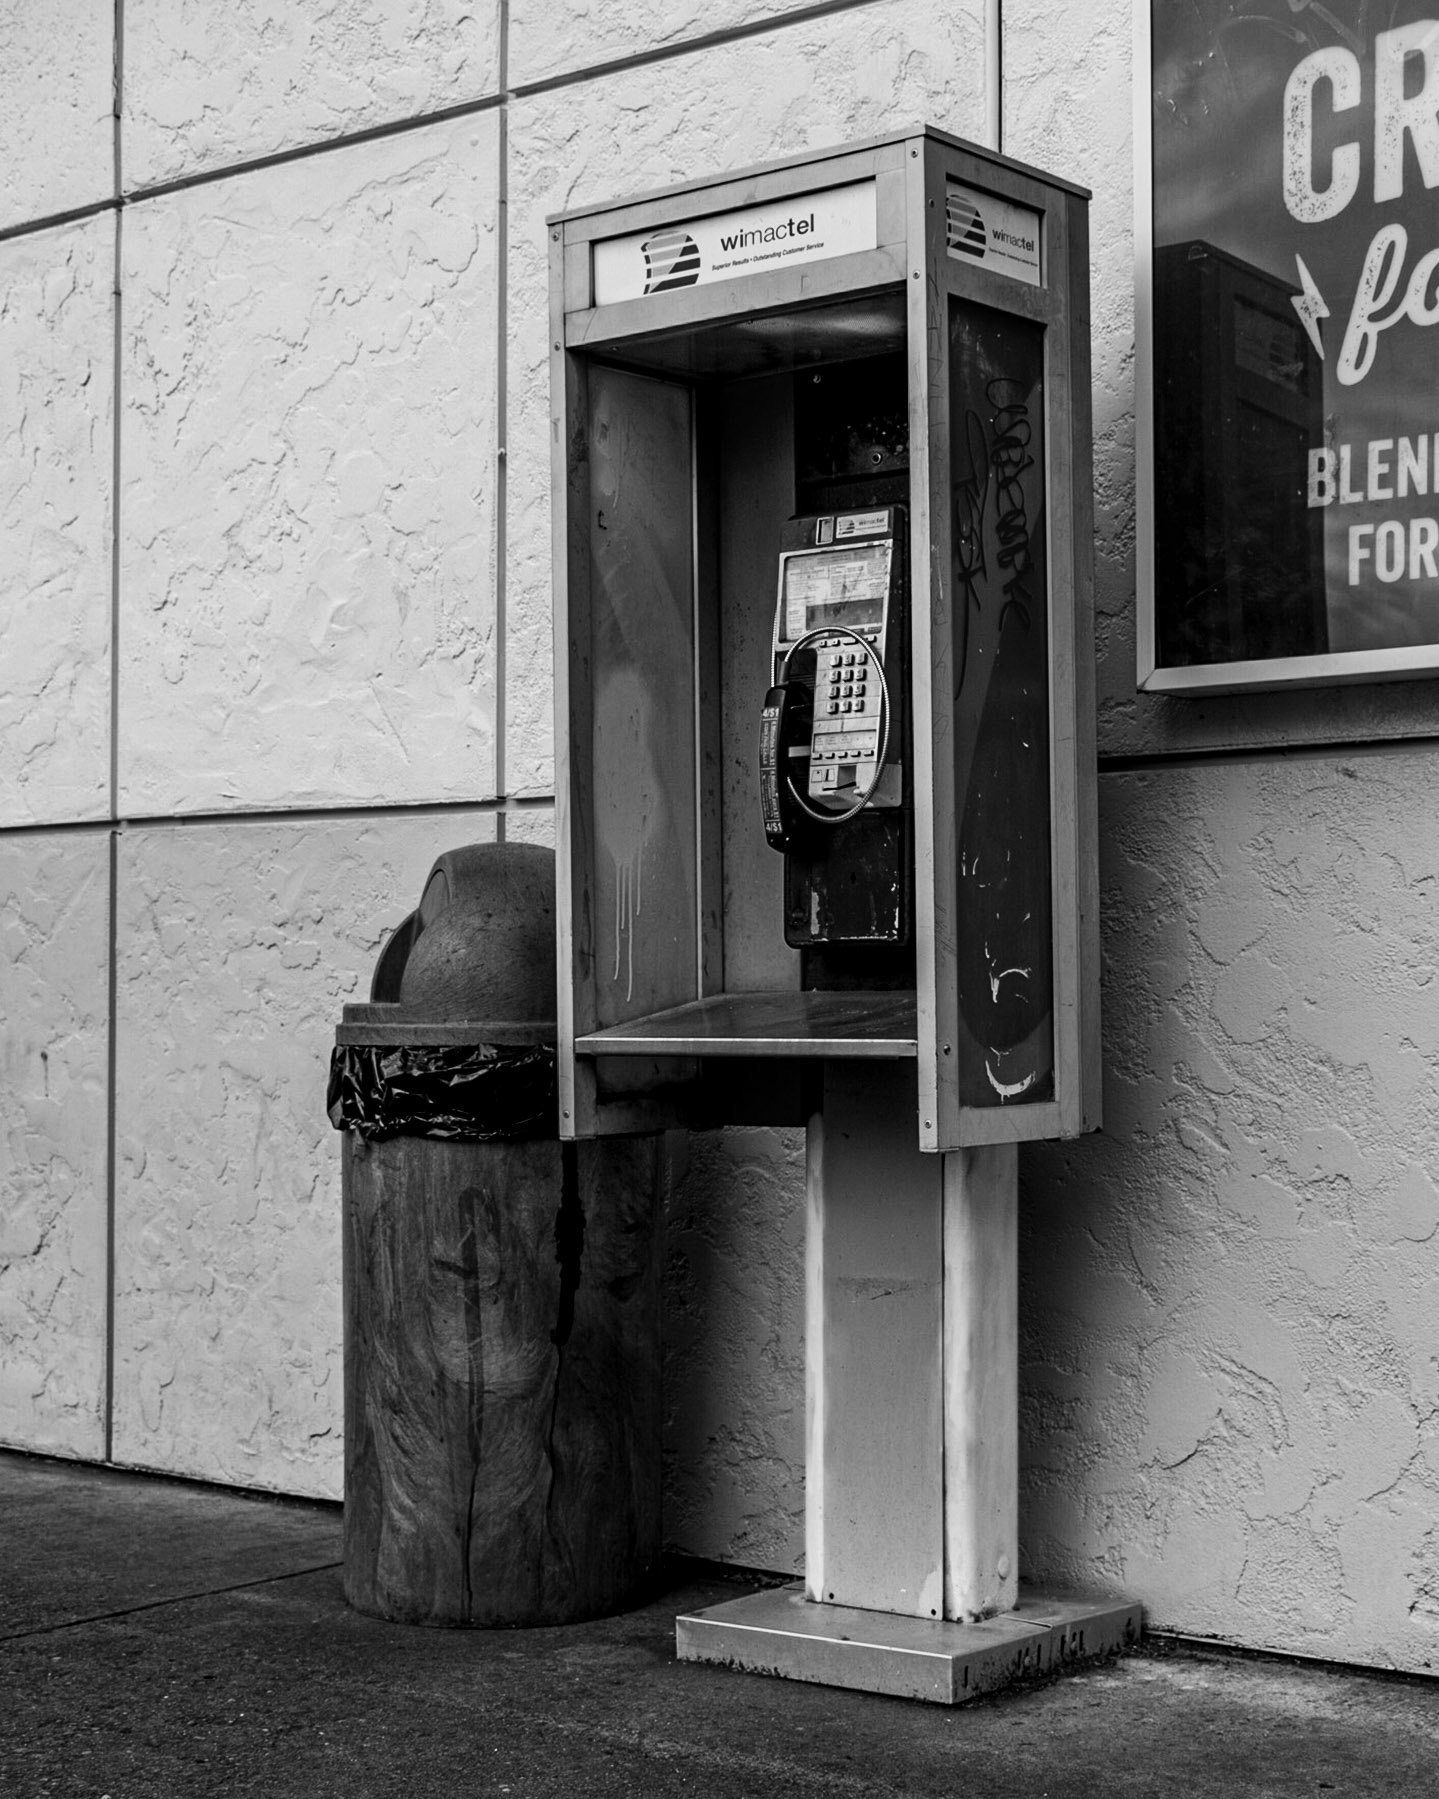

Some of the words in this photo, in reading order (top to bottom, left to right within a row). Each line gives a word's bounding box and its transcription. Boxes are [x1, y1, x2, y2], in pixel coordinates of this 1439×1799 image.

[721, 213, 815, 251] wimactel
[992, 228, 1034, 252] wimactel
[712, 262, 731, 271] Superior
[732, 258, 749, 266] Results
[753, 251, 782, 262] Outstanding
[782, 246, 806, 256] Customer
[806, 242, 824, 251] Service
[1307, 432, 1439, 508] BLEN
[1348, 517, 1439, 586] FOR
